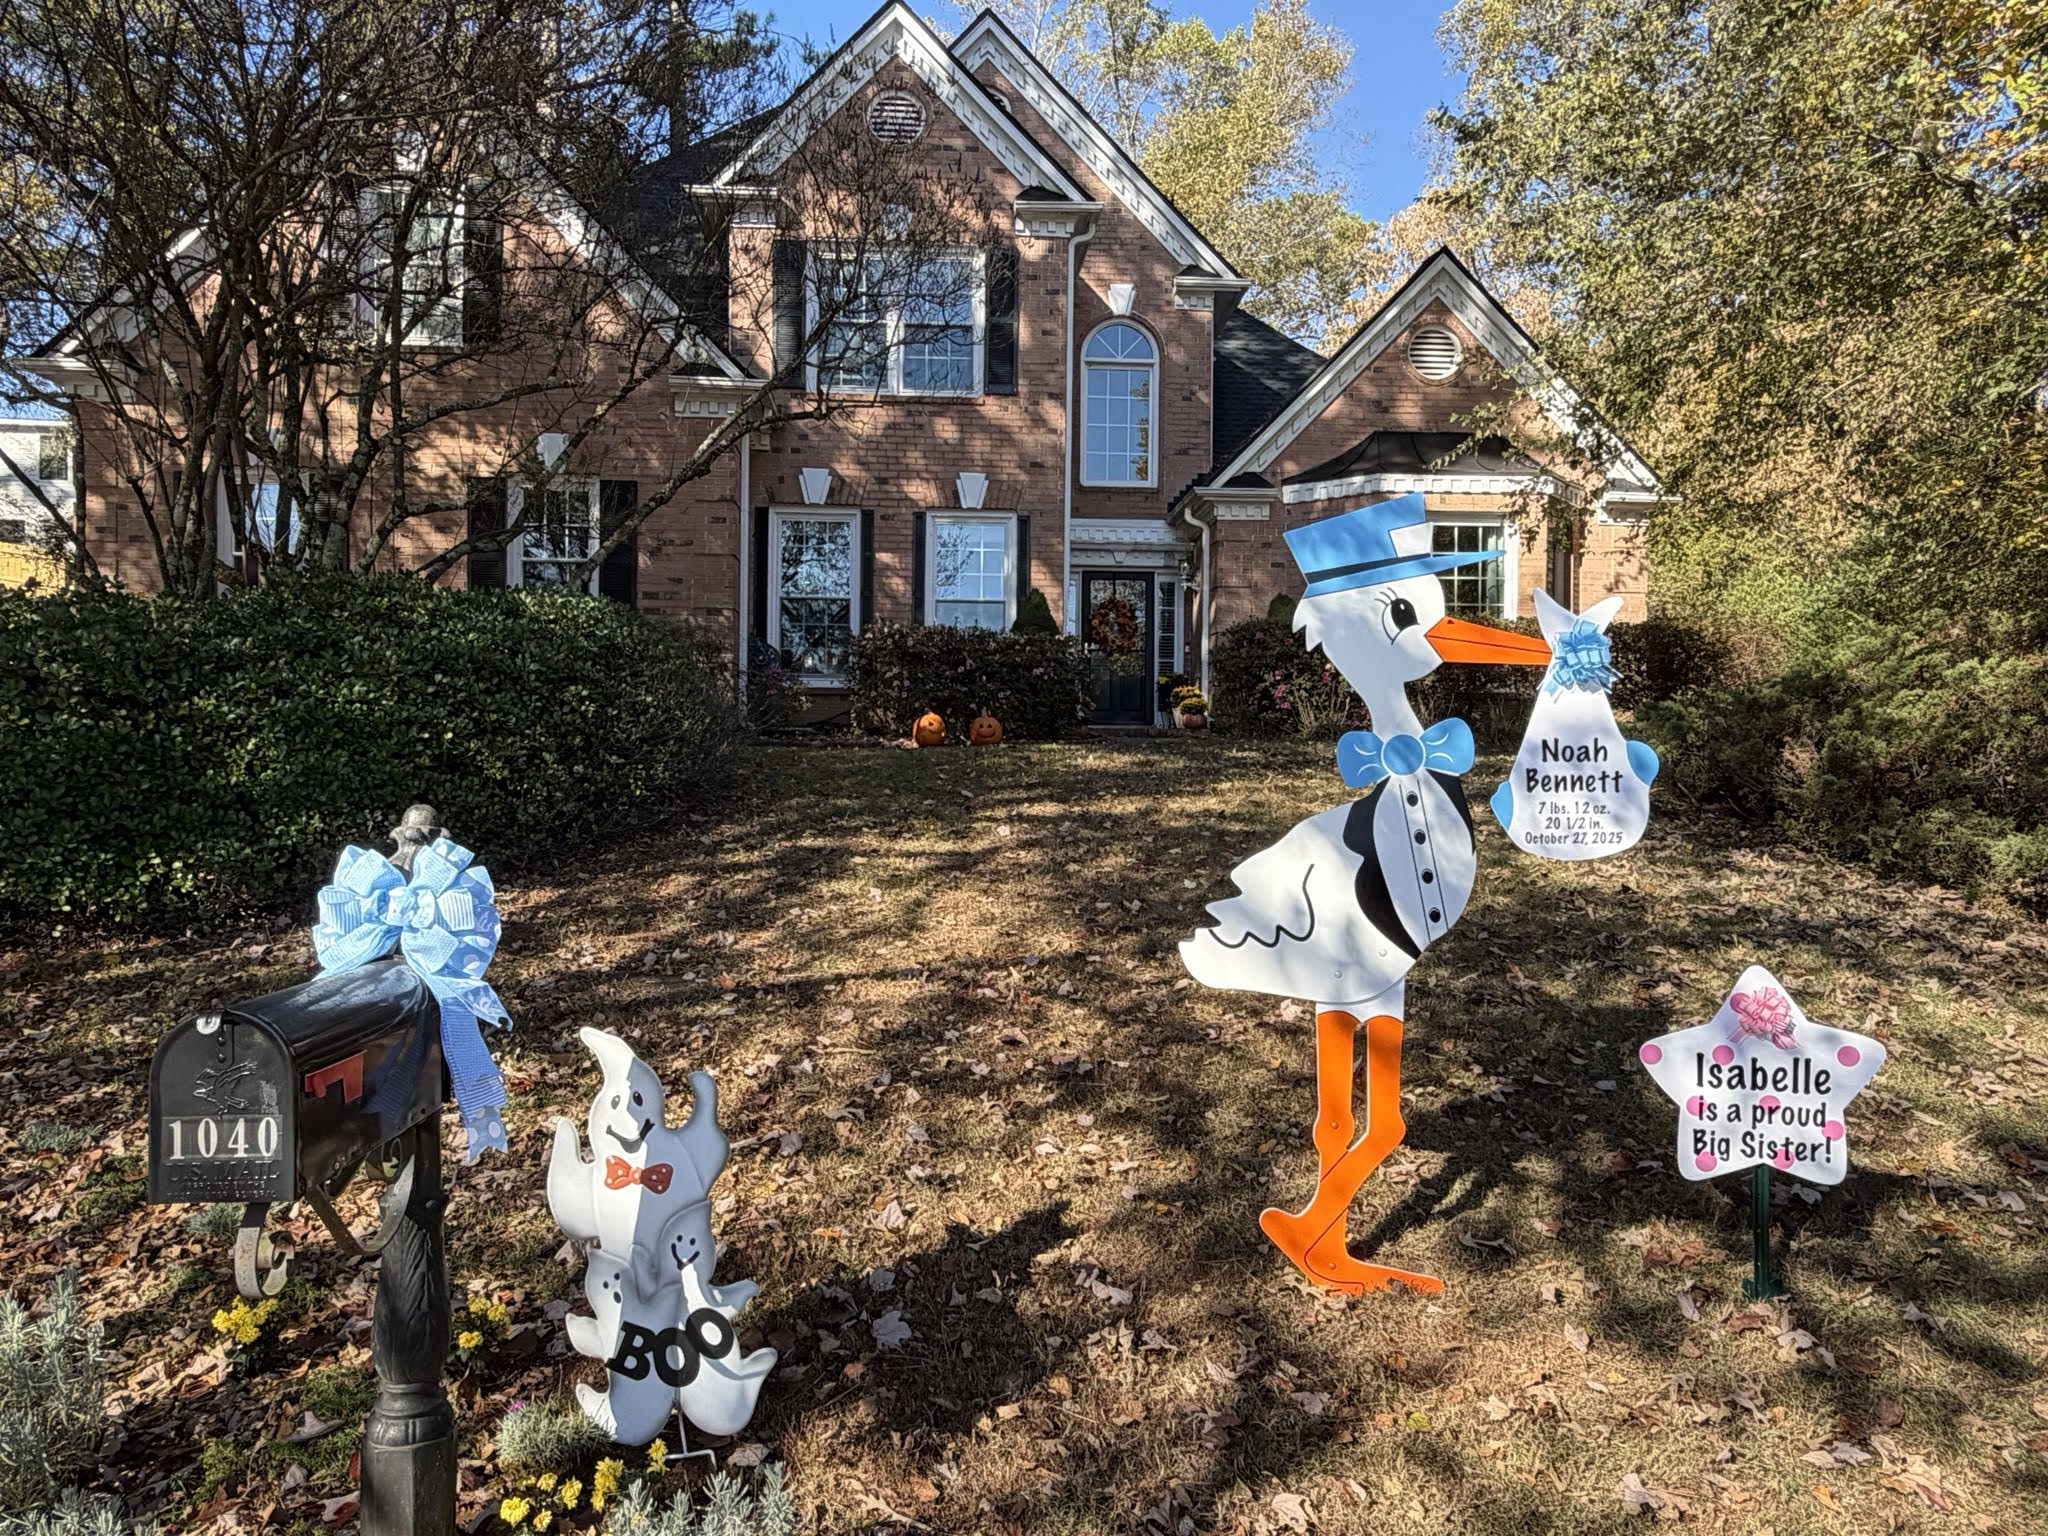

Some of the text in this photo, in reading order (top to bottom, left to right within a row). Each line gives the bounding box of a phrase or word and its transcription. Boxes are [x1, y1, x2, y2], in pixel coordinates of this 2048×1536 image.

[1542, 737, 1608, 762] Noah
[1525, 768, 1623, 793] Bennett
[1538, 802, 1546, 814] 7
[1550, 802, 1570, 814] lbs.
[1593, 804, 1610, 814] oz.
[1545, 817, 1604, 830] 20 1/2 in.
[1525, 832, 1623, 845] October 27, 2025
[1696, 1052, 1832, 1095] Isabelle
[1698, 1096, 1827, 1129] is a proud
[169, 1117, 278, 1160] 1040
[1693, 1129, 1831, 1163] Big Sister!
[605, 1307, 734, 1387] BOO
